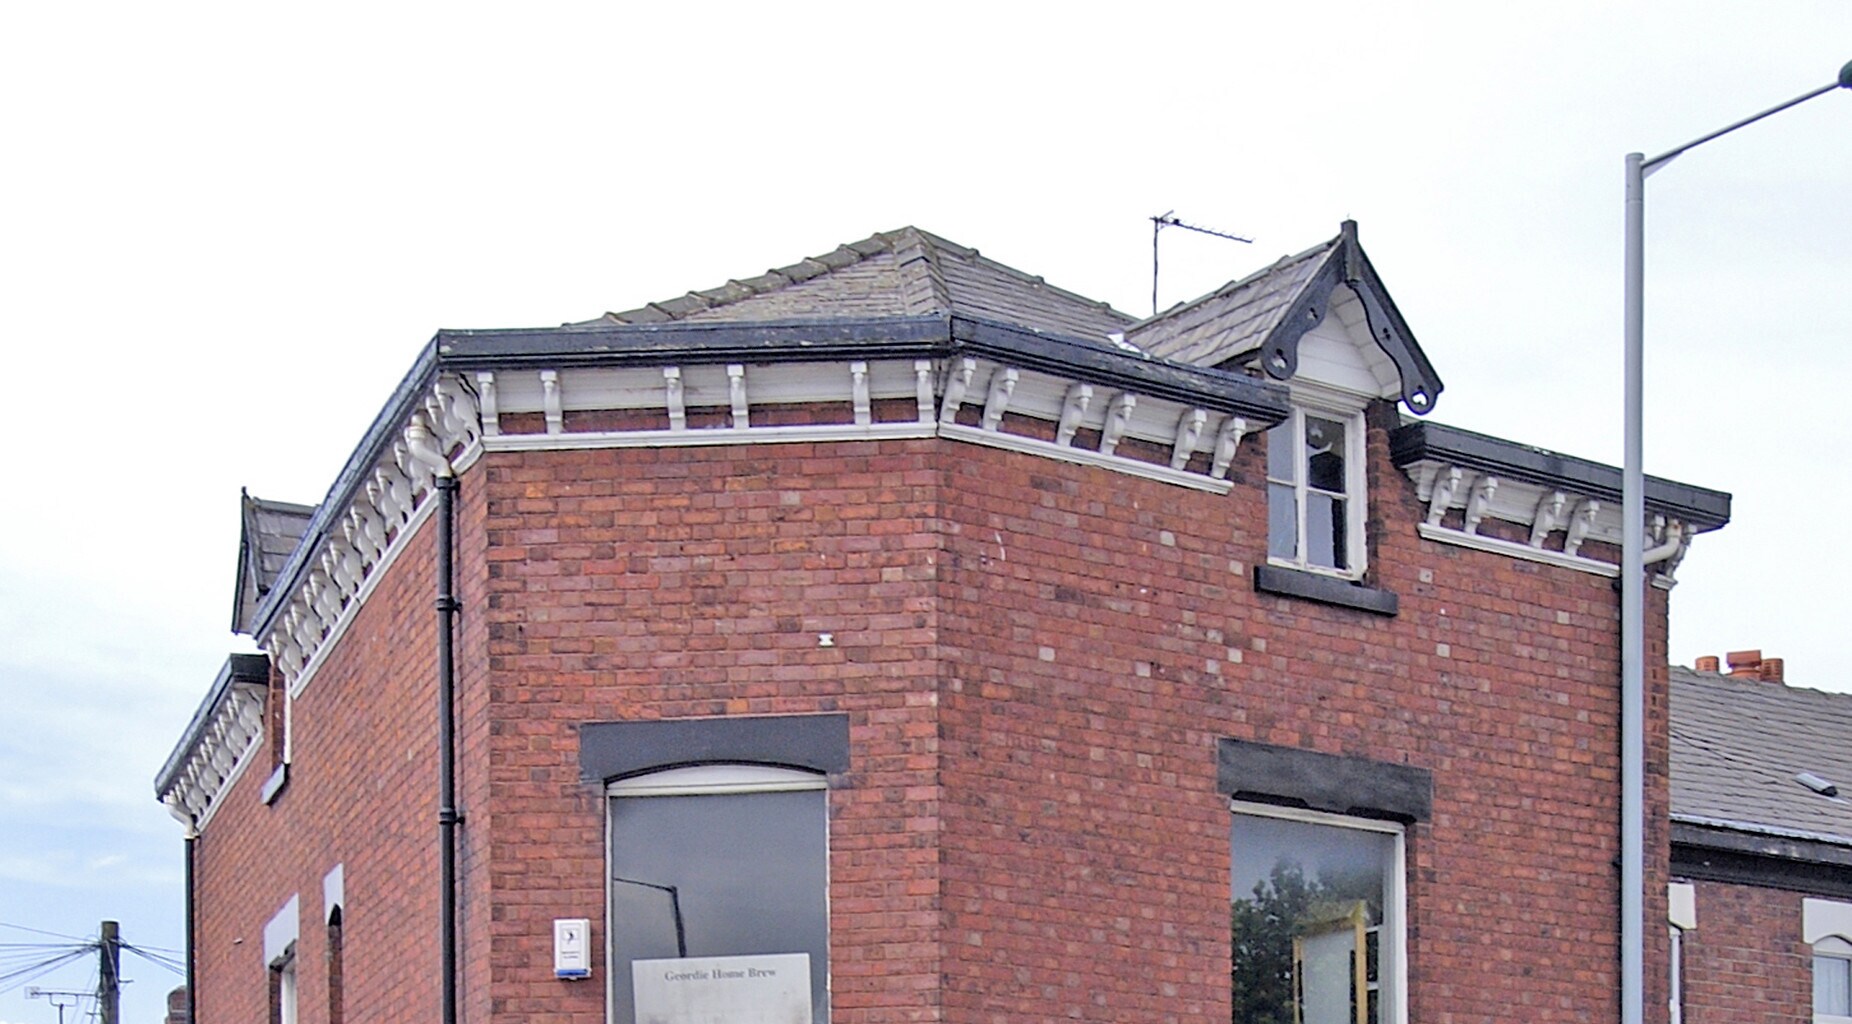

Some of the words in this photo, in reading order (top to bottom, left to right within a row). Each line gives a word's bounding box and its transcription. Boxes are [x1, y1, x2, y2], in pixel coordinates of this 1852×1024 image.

[664, 970, 709, 981] Geordie
[712, 969, 745, 979] Home
[748, 967, 776, 978] Brew
